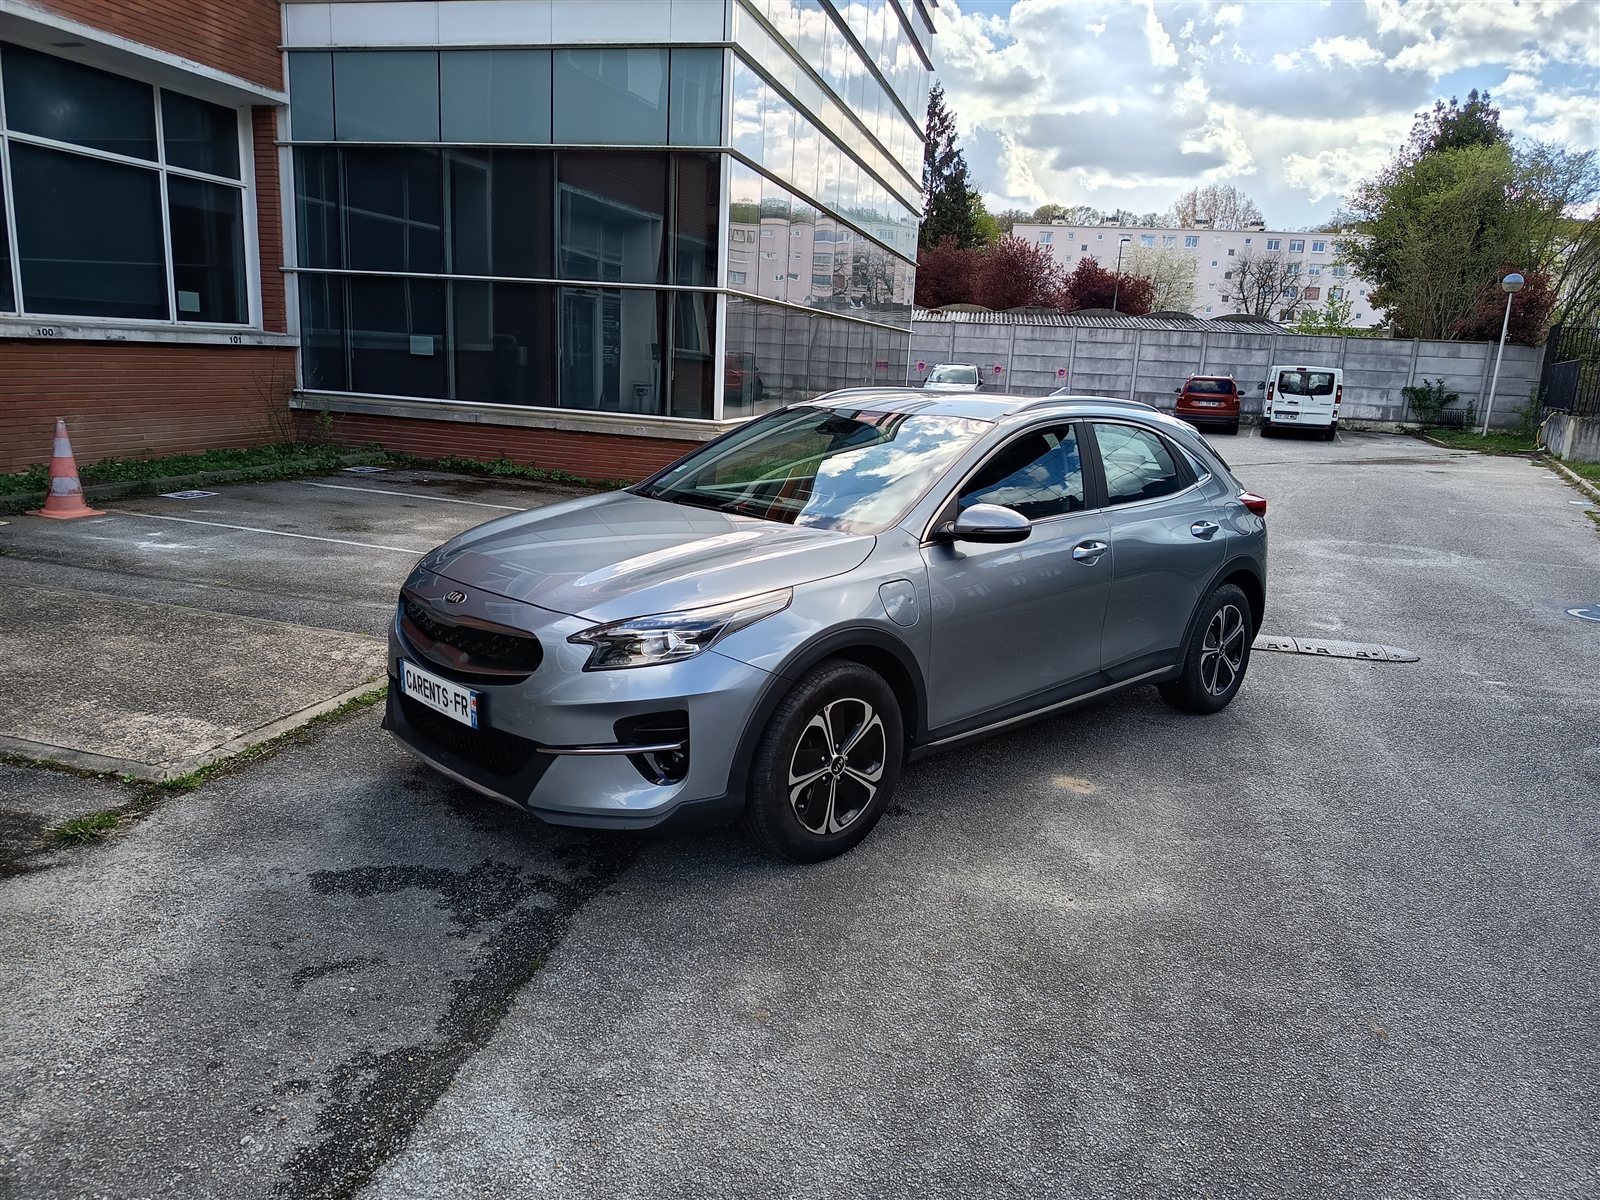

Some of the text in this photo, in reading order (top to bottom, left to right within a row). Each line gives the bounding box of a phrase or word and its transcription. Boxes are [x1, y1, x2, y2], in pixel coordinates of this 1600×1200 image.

[36, 328, 54, 336] 100
[229, 335, 242, 344] 101
[445, 591, 463, 603] KIA
[406, 669, 469, 718] CARENTS-FR
